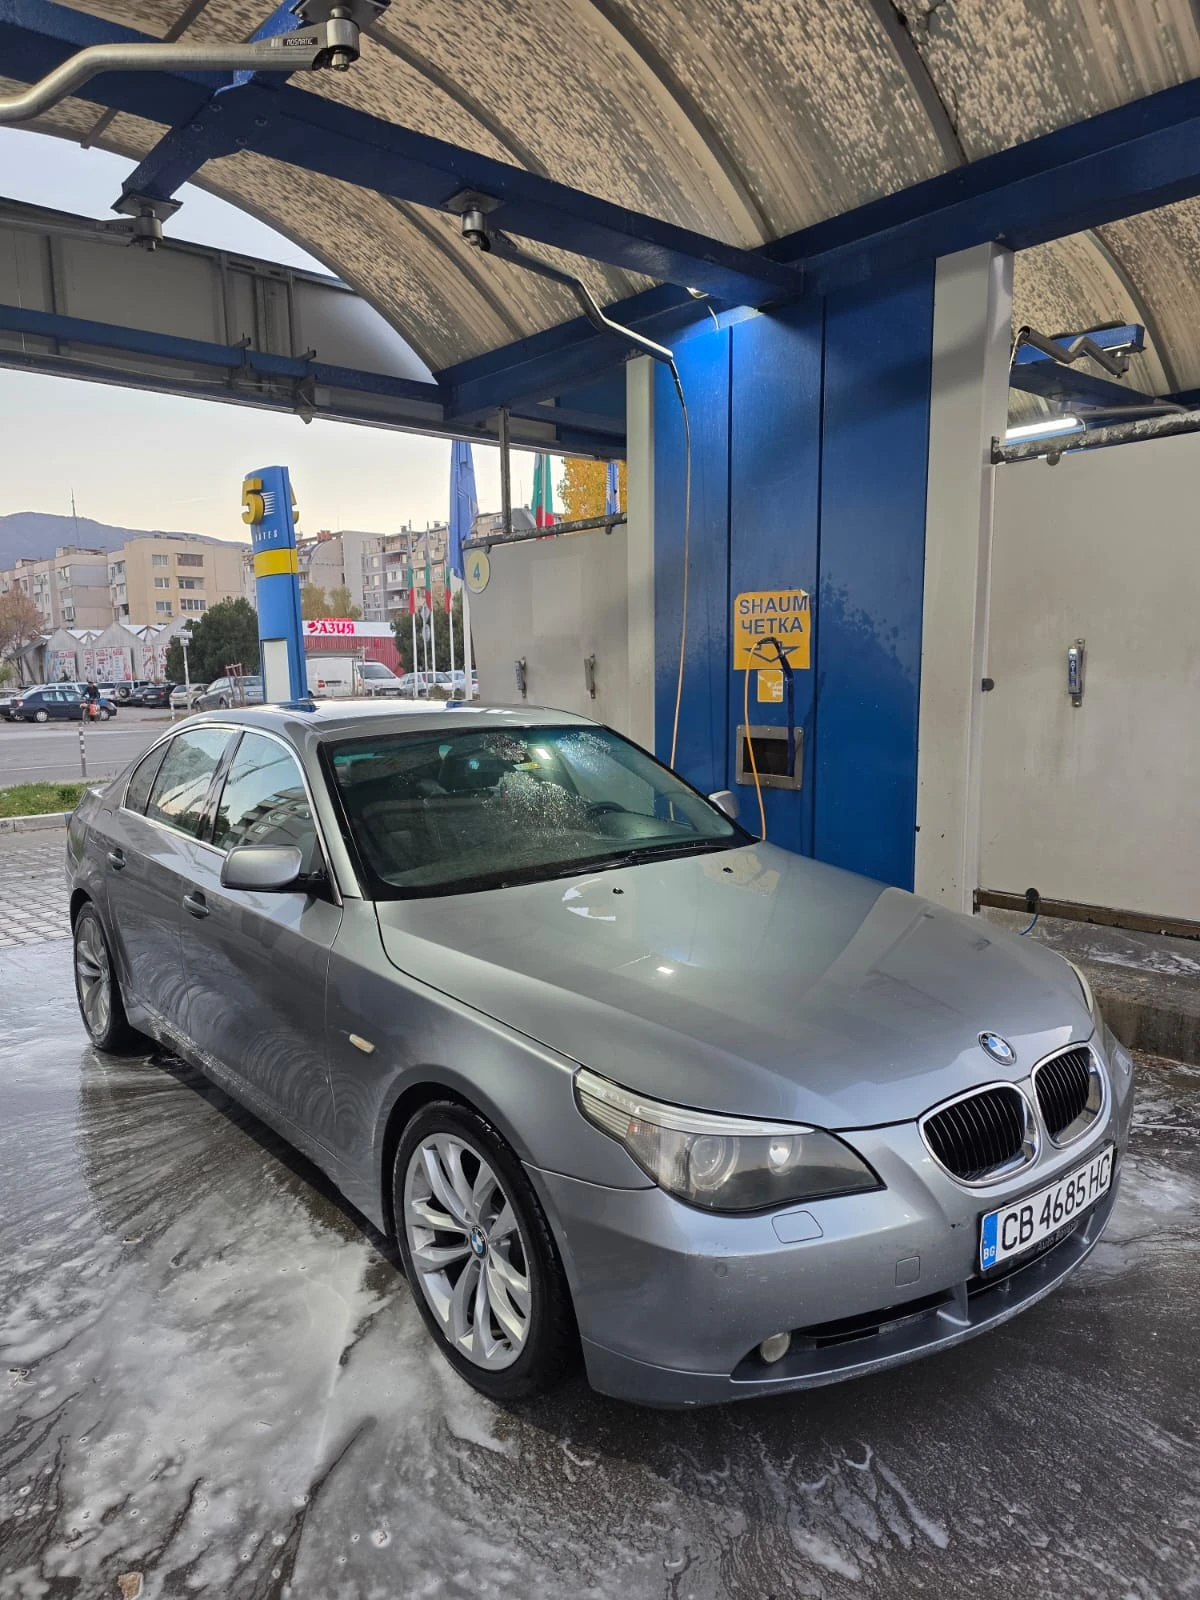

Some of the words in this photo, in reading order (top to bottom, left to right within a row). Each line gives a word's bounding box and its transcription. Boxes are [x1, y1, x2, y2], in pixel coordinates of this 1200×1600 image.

[241, 477, 264, 525] 5
[473, 562, 480, 581] 4
[739, 595, 809, 615] SHAUM
[741, 616, 803, 635] ЧЕТКА
[1039, 1177, 1086, 1231] 4685
[983, 1245, 995, 1260] BG
